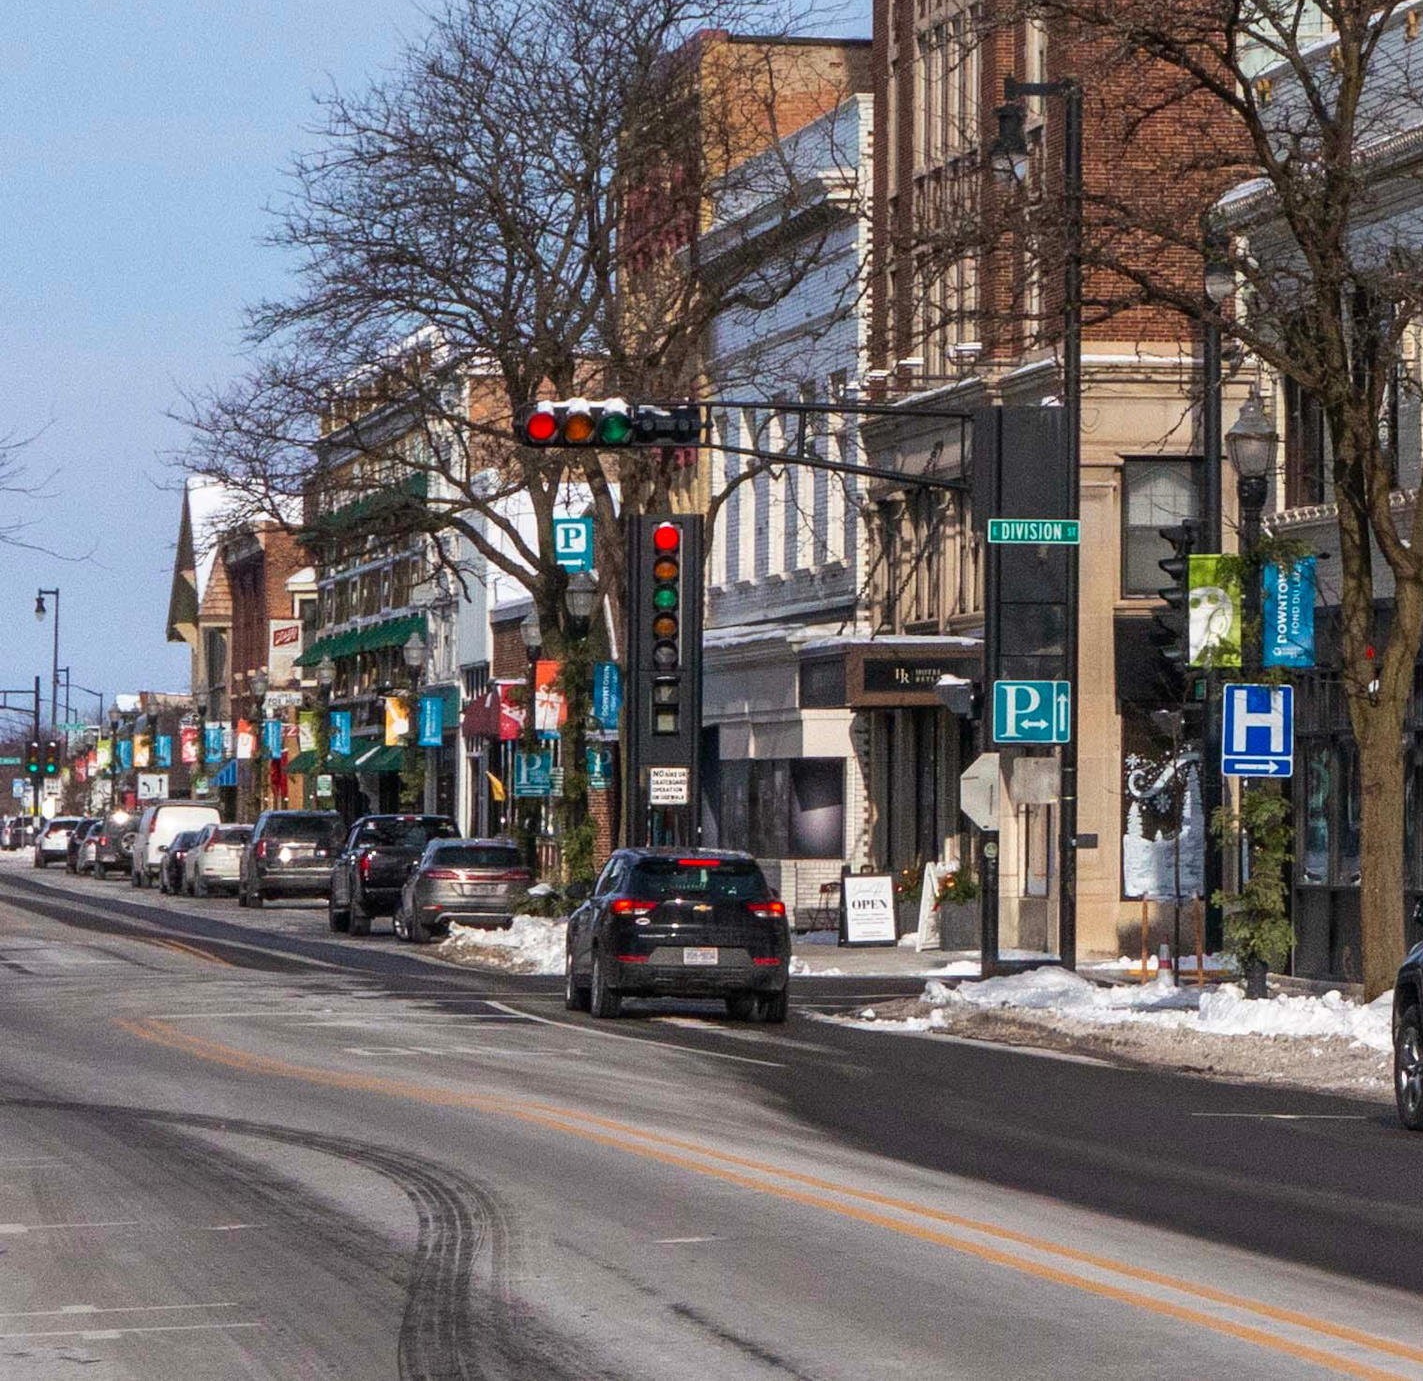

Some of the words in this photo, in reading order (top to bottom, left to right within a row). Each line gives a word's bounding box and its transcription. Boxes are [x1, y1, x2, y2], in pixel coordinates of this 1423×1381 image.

[560, 527, 582, 549] P
[1001, 522, 1062, 540] DIVISION
[1066, 526, 1077, 537] ST
[1277, 566, 1289, 644] DOWNTOW
[1291, 608, 1301, 635] FOND
[999, 685, 1041, 738] P
[1232, 688, 1284, 753] H
[516, 753, 542, 785] P
[652, 770, 665, 778] NO
[851, 898, 888, 910] OPEN
